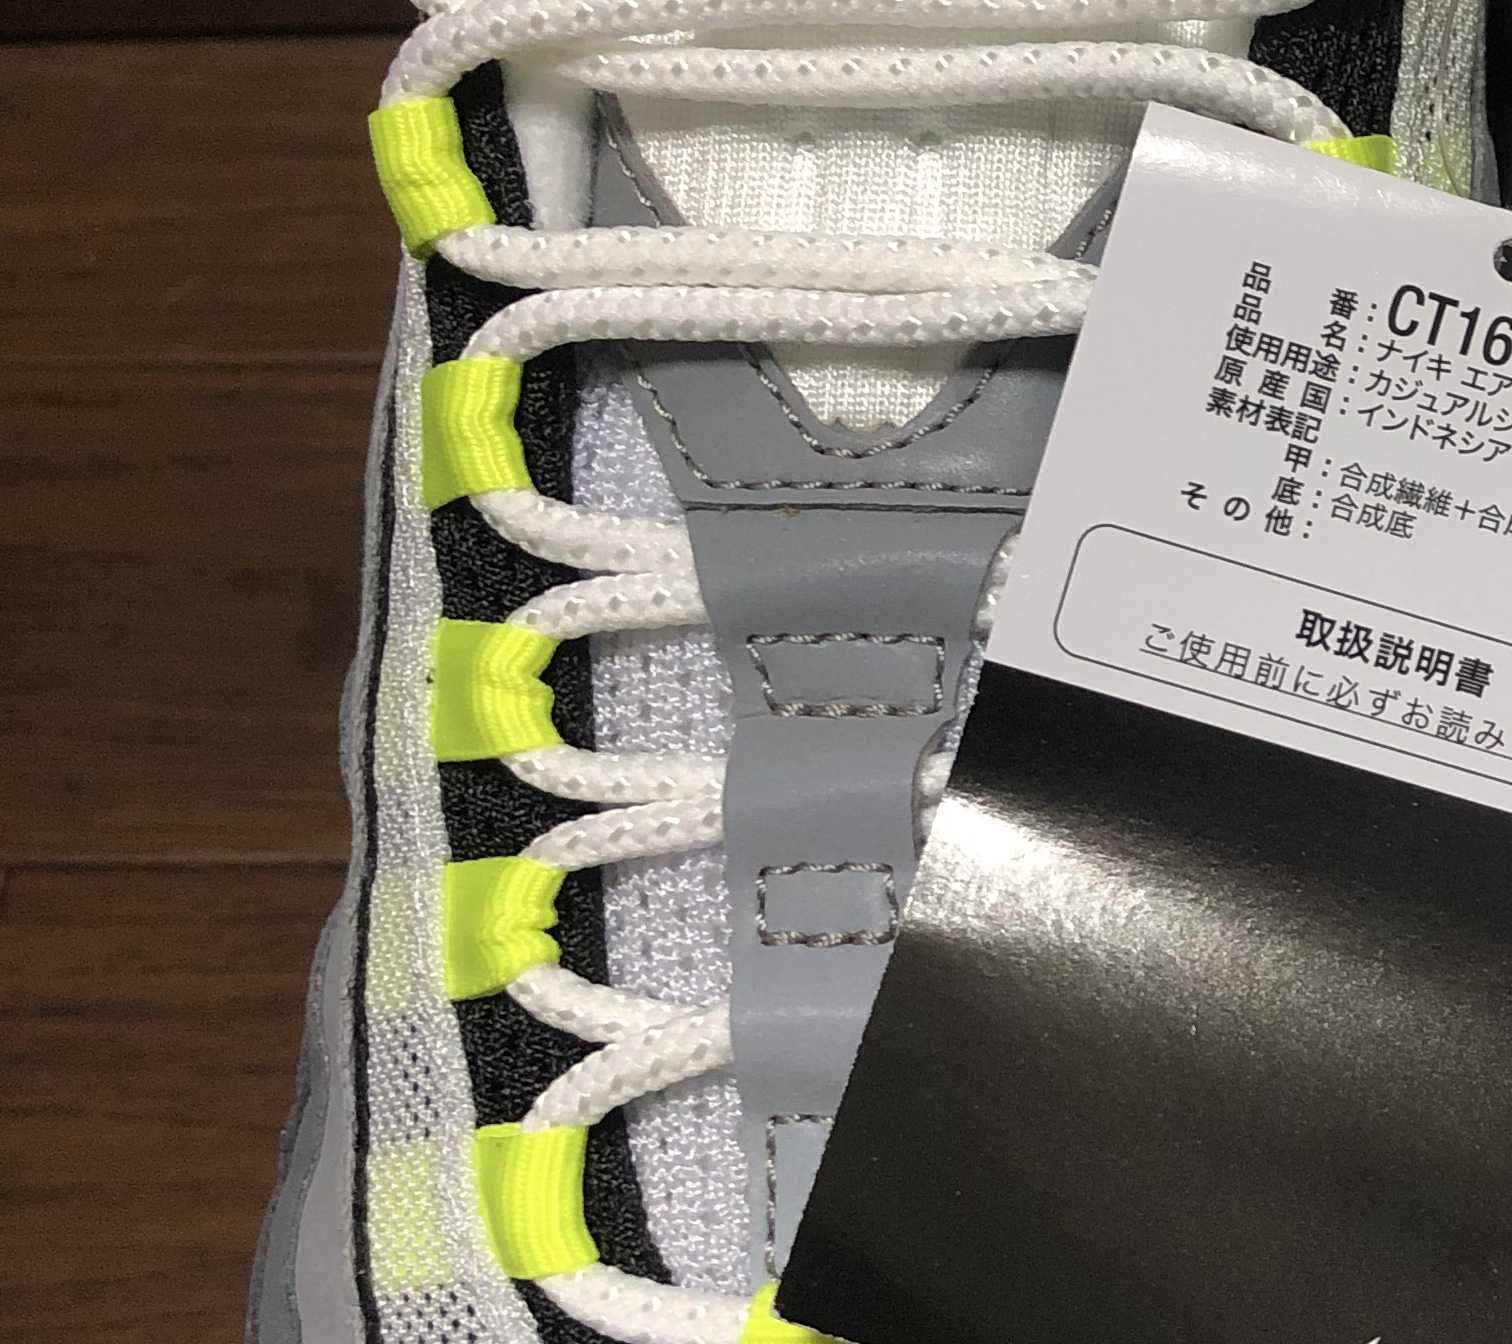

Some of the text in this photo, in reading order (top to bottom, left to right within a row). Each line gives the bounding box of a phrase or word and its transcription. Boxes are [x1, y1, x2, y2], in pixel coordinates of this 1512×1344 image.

[1204, 386, 1323, 444] 素材表記
[1358, 403, 1512, 462] インドネシア
[1330, 493, 1418, 540] 合成底
[1295, 609, 1496, 698] 取扱説明書
